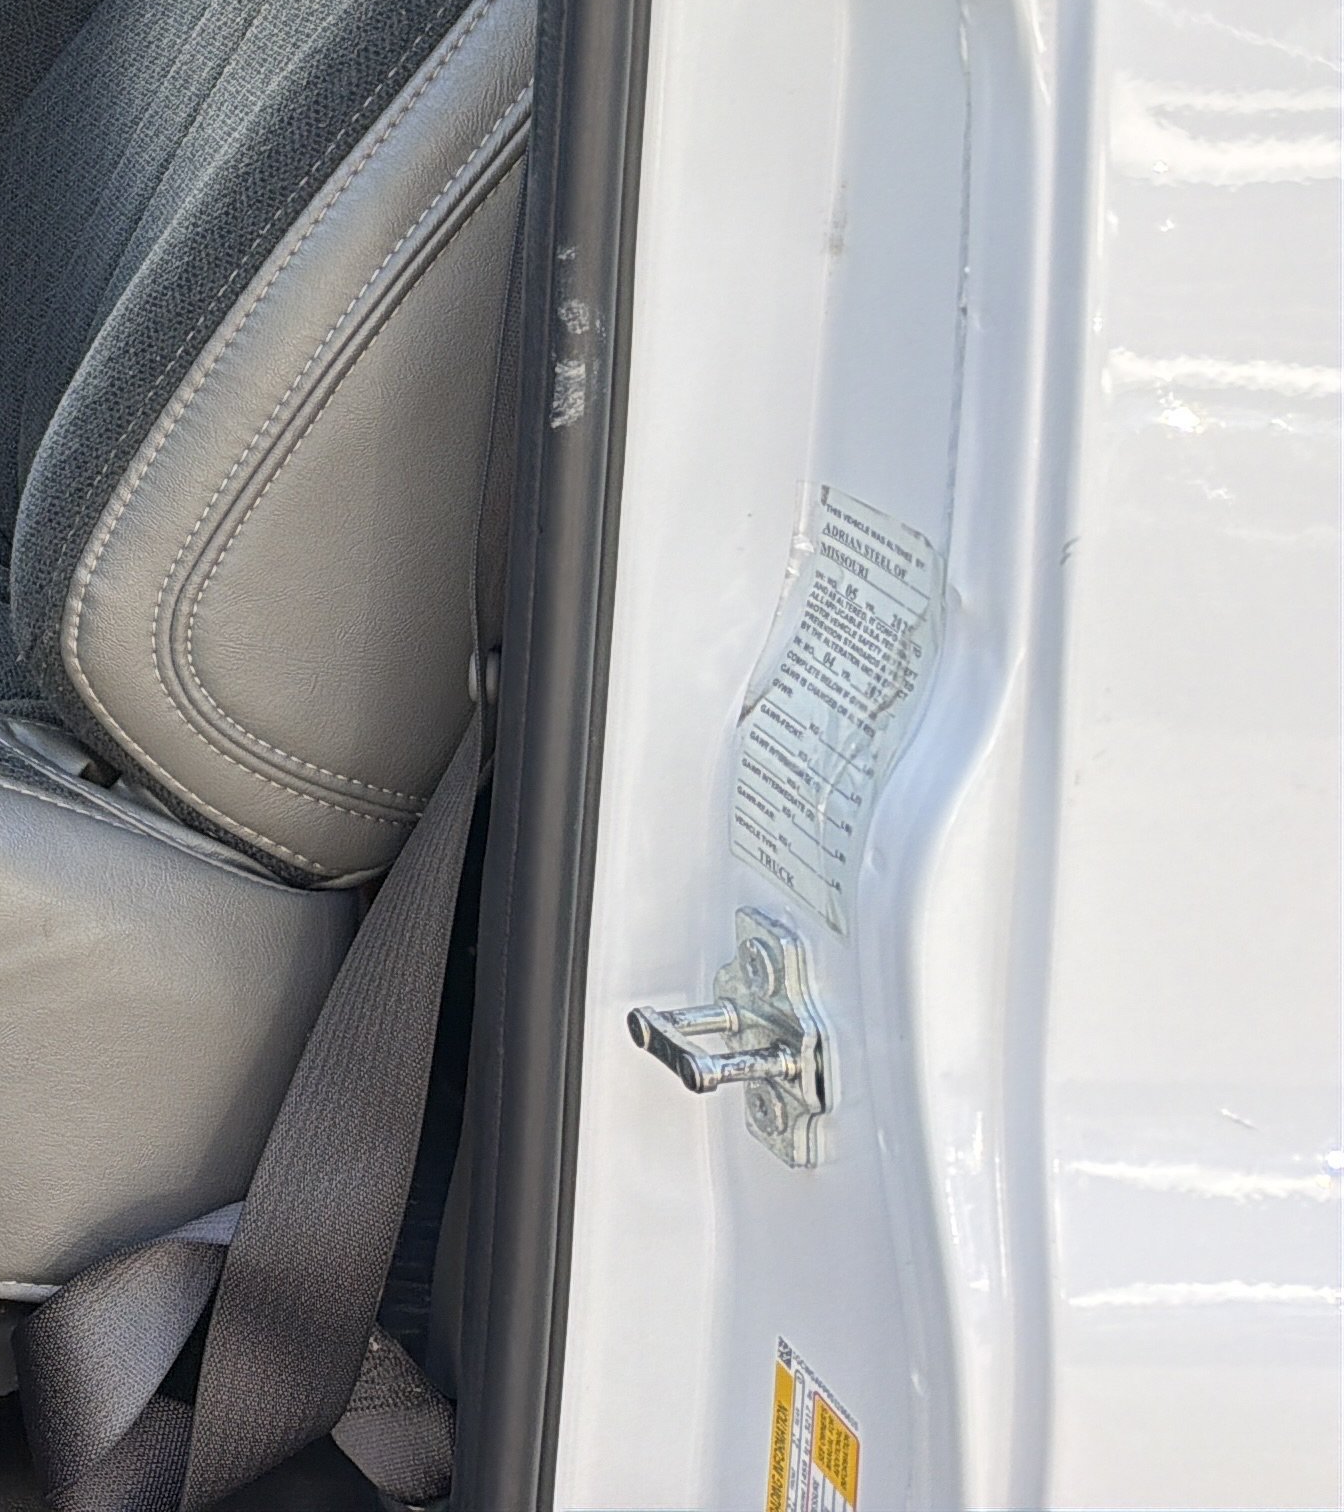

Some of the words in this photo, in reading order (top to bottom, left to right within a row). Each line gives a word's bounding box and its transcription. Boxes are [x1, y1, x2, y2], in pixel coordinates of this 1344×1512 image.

[826, 504, 841, 518] THIS
[843, 514, 870, 534] VEHICLE
[871, 531, 886, 544] WAS
[821, 542, 869, 580] MISSOURI
[822, 523, 862, 551] ADRIAN
[864, 544, 893, 574] STEEL
[894, 568, 907, 579] OF
[806, 600, 830, 622] MOTOR
[845, 584, 859, 600] 05
[786, 650, 820, 679] COMPLETE
[820, 672, 843, 694] BELOW
[822, 652, 837, 668] 04
[734, 813, 761, 839] VEHICLE
[758, 847, 795, 888] TRUCK
